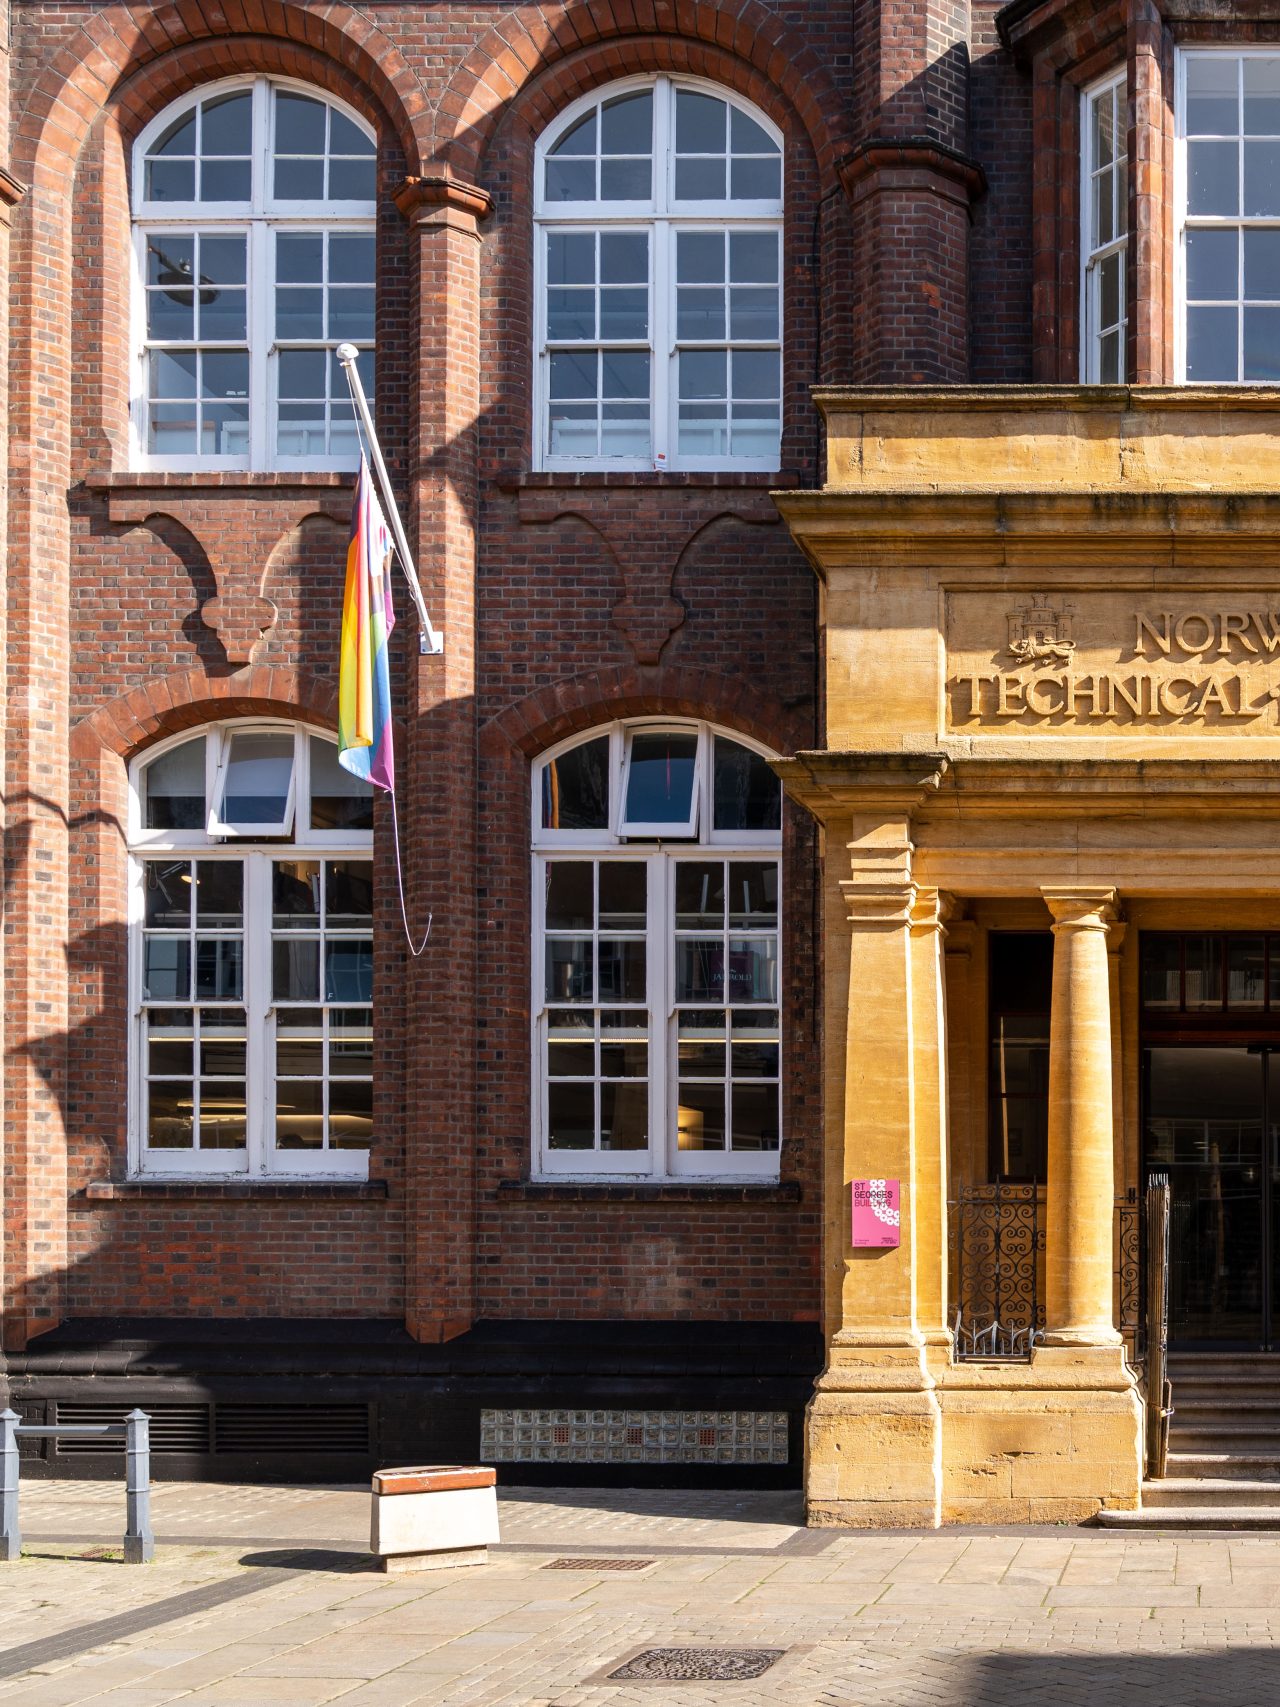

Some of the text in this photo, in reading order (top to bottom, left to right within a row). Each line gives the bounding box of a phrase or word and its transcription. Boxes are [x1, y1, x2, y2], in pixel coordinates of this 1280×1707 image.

[956, 674, 1268, 717] TECHNICAL
[854, 1182, 865, 1190] ST
[854, 1190, 893, 1199] GEORGES
